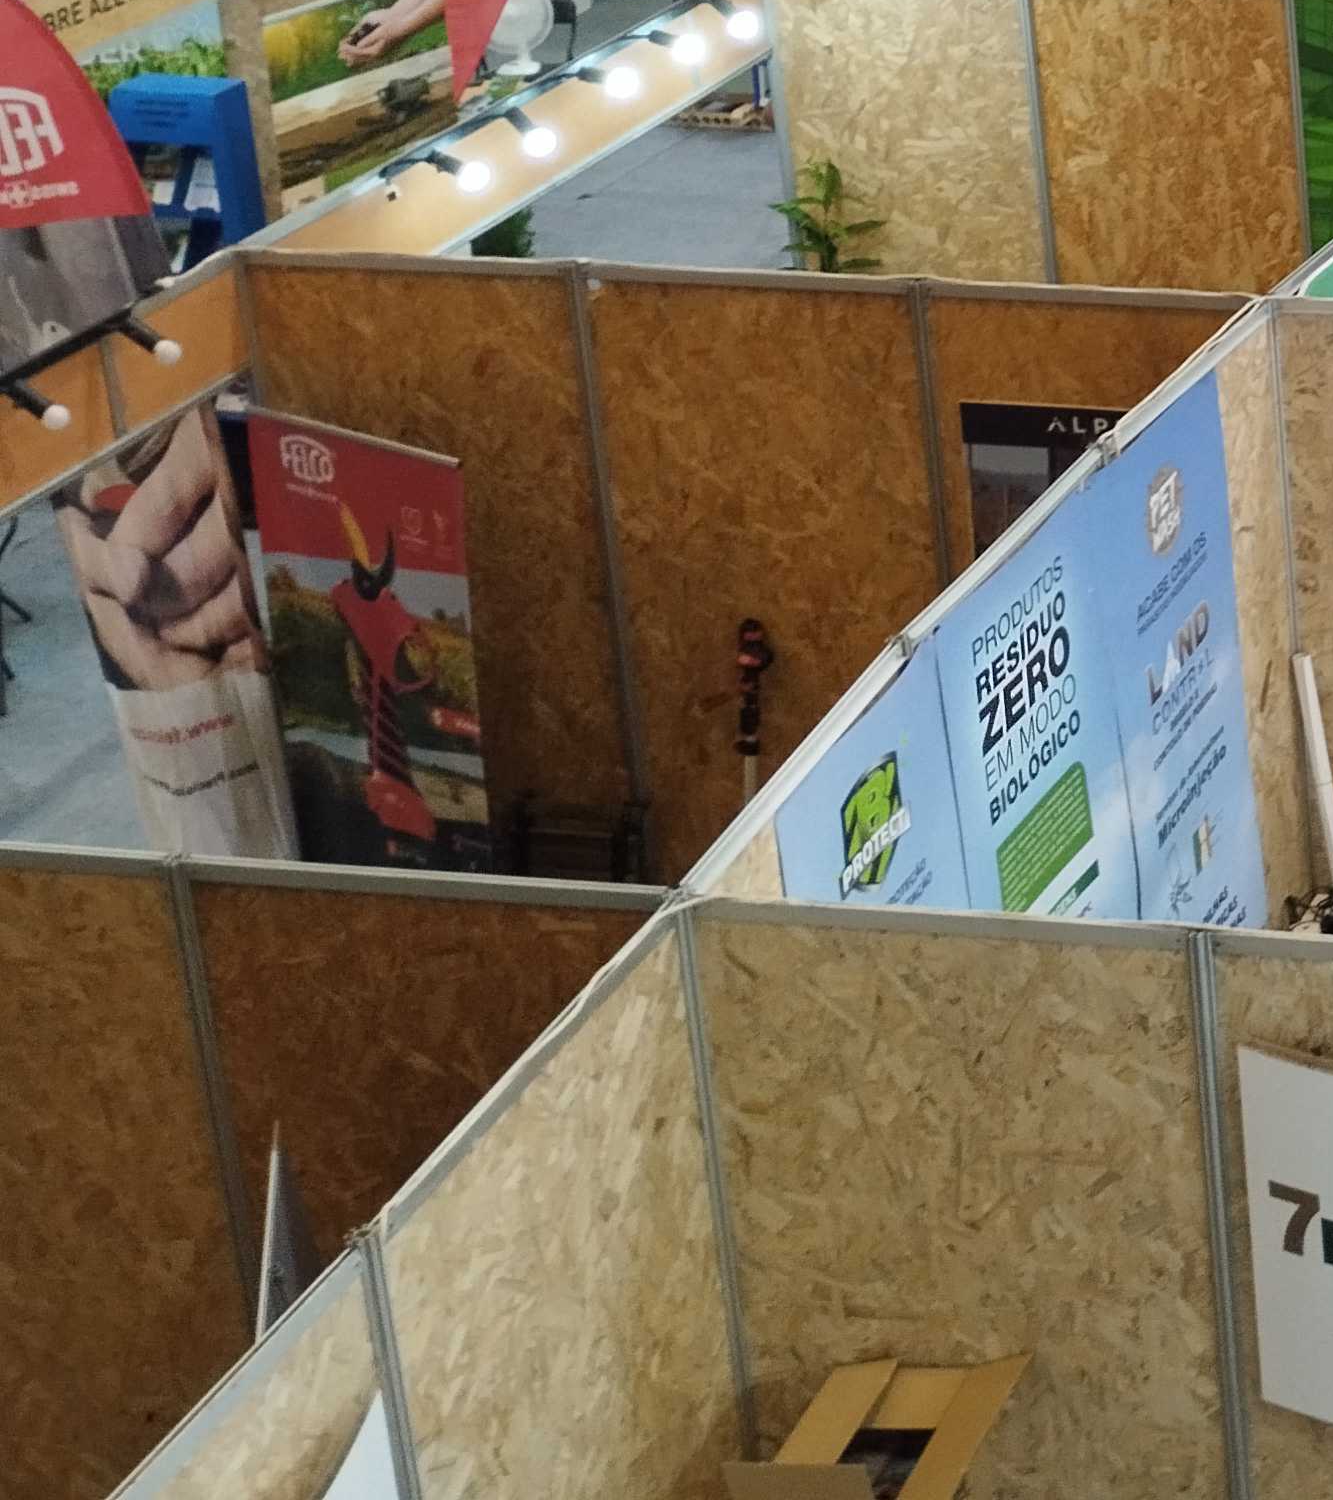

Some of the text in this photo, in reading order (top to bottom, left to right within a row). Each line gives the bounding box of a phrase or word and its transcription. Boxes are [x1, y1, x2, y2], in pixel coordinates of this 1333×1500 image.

[971, 554, 1065, 667] PRODUTOS
[975, 588, 1068, 704] RESÍDUO
[979, 626, 1071, 758] ZERO
[984, 673, 1078, 793] EM MODO
[989, 708, 1082, 827] BIOLÓGICO
[1268, 1179, 1320, 1257] 7
